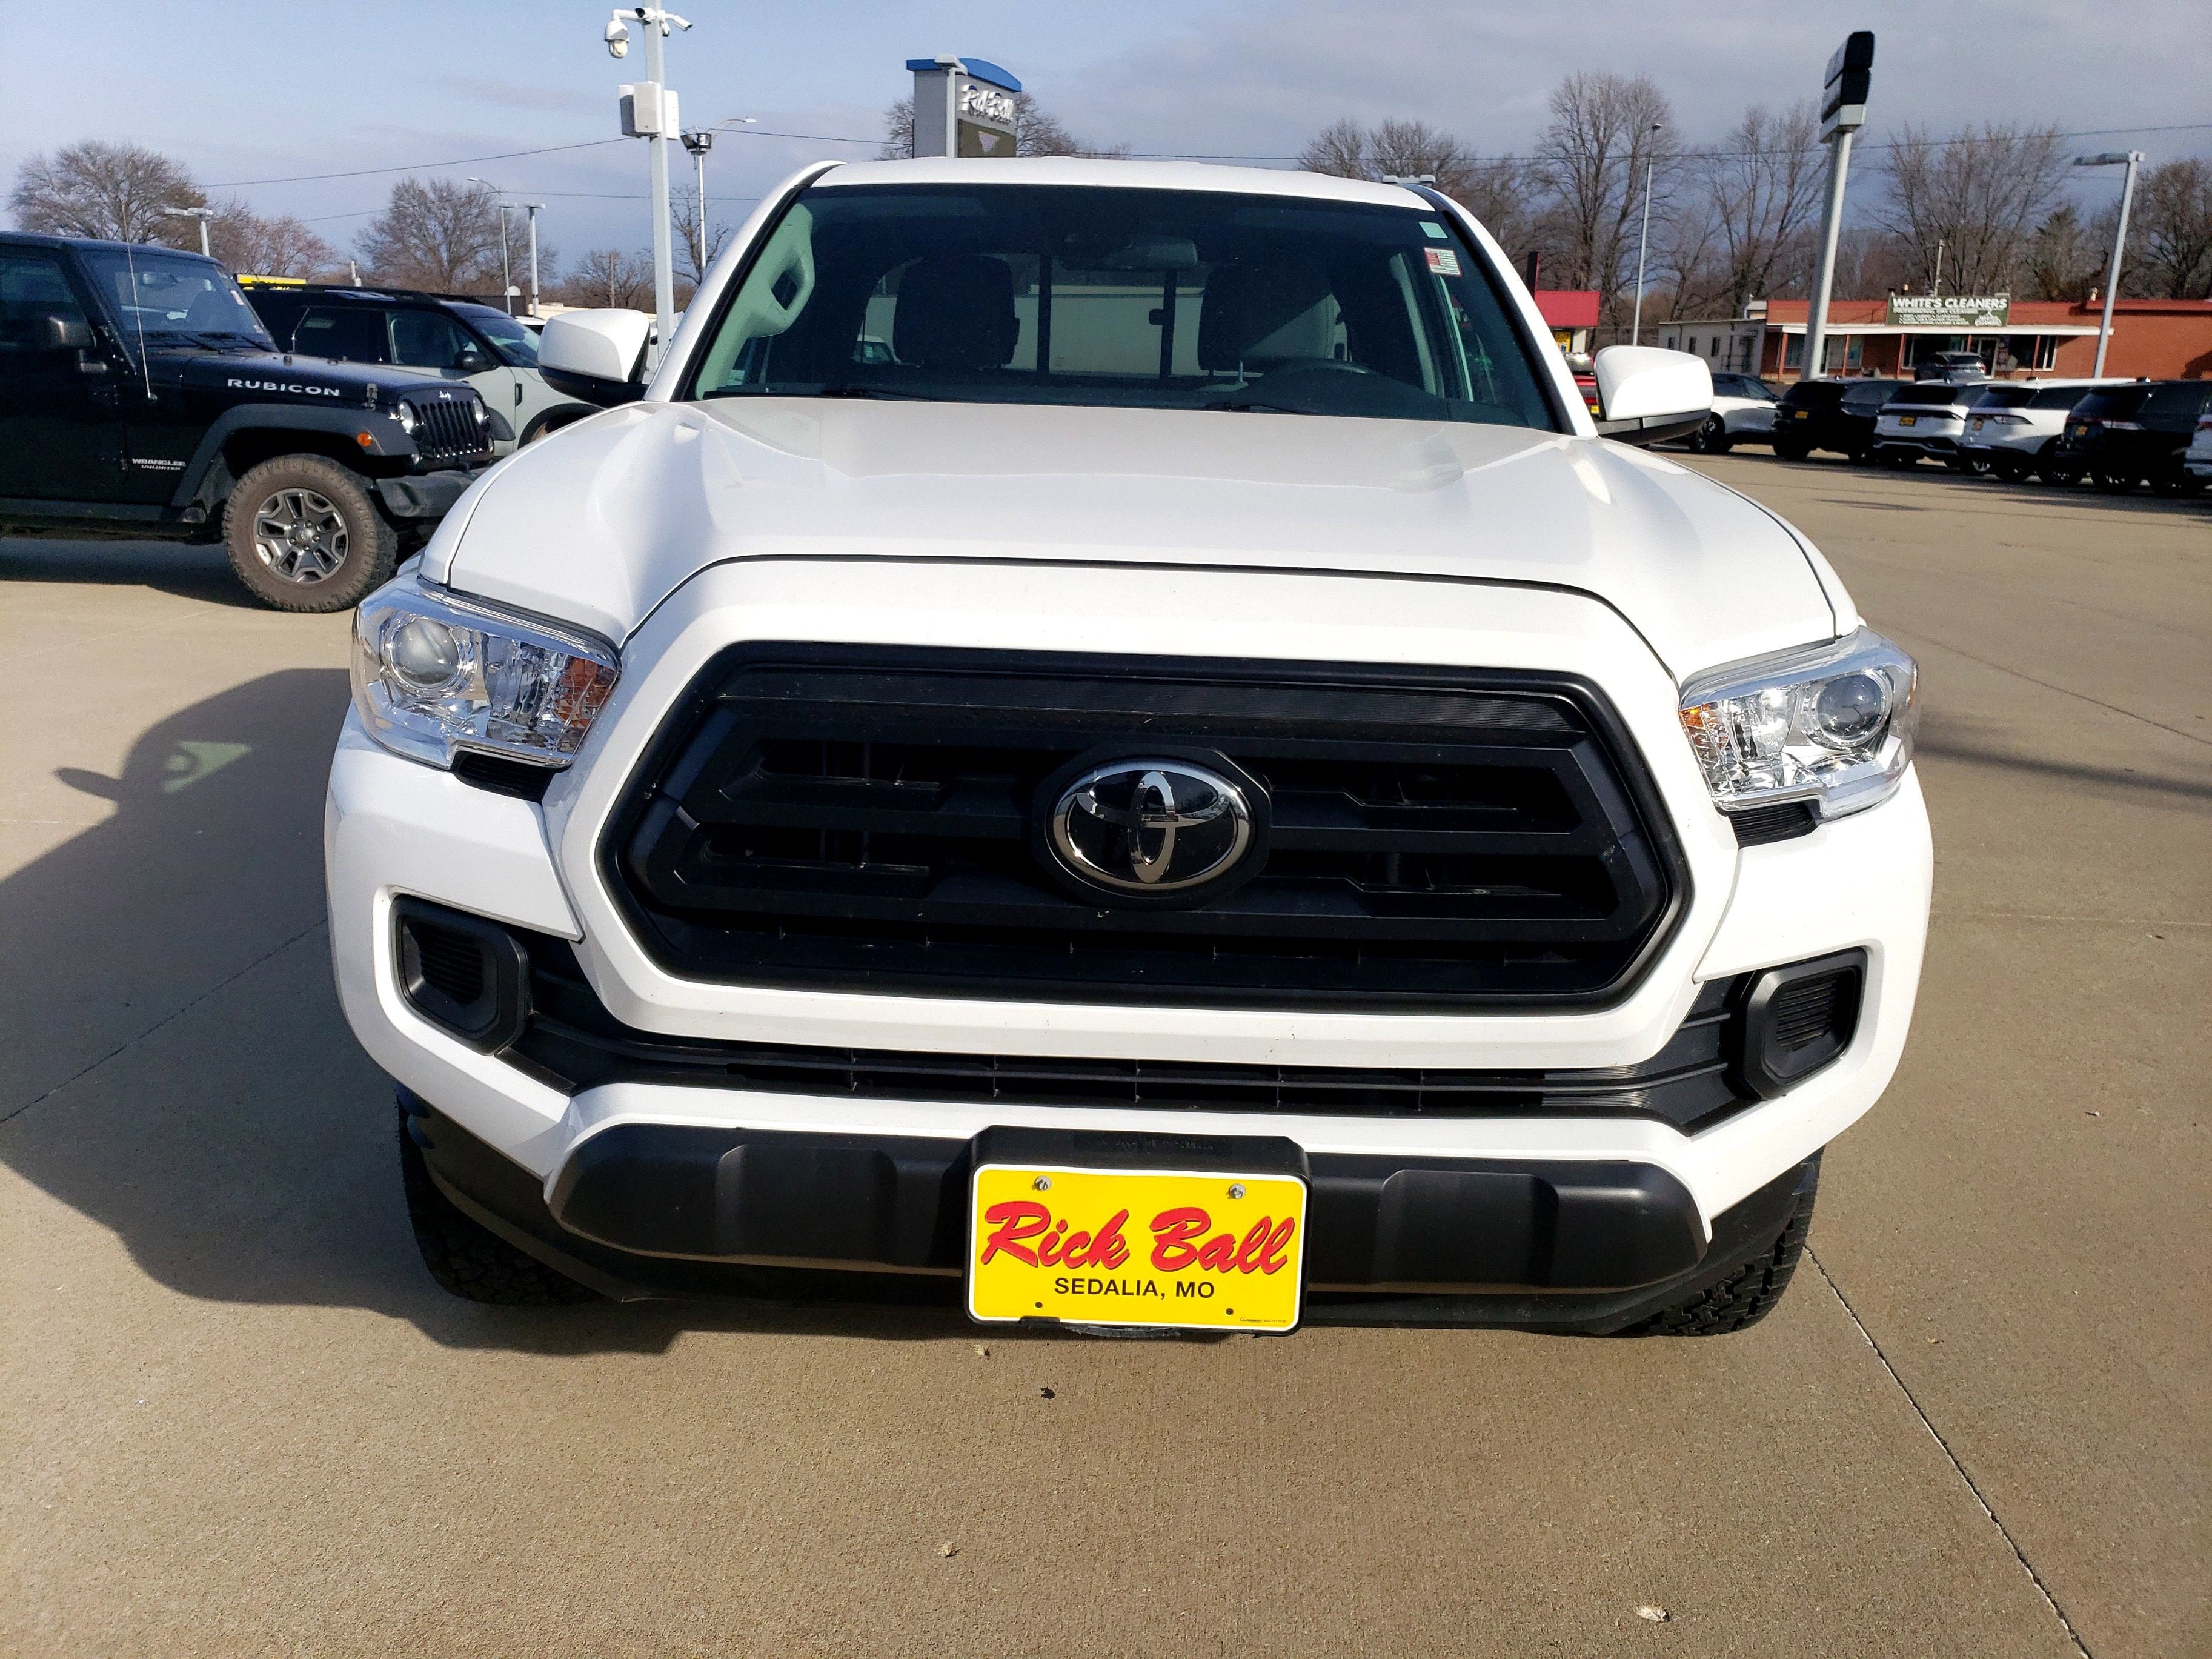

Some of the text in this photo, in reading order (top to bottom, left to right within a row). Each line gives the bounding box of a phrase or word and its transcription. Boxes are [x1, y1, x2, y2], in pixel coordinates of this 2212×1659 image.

[1893, 297, 2008, 310] WHITE'S CLEANERS
[227, 379, 340, 396] RUBICON
[981, 1200, 1295, 1275] Rick Ball
[1054, 1277, 1215, 1300] SEDALIA, MO
